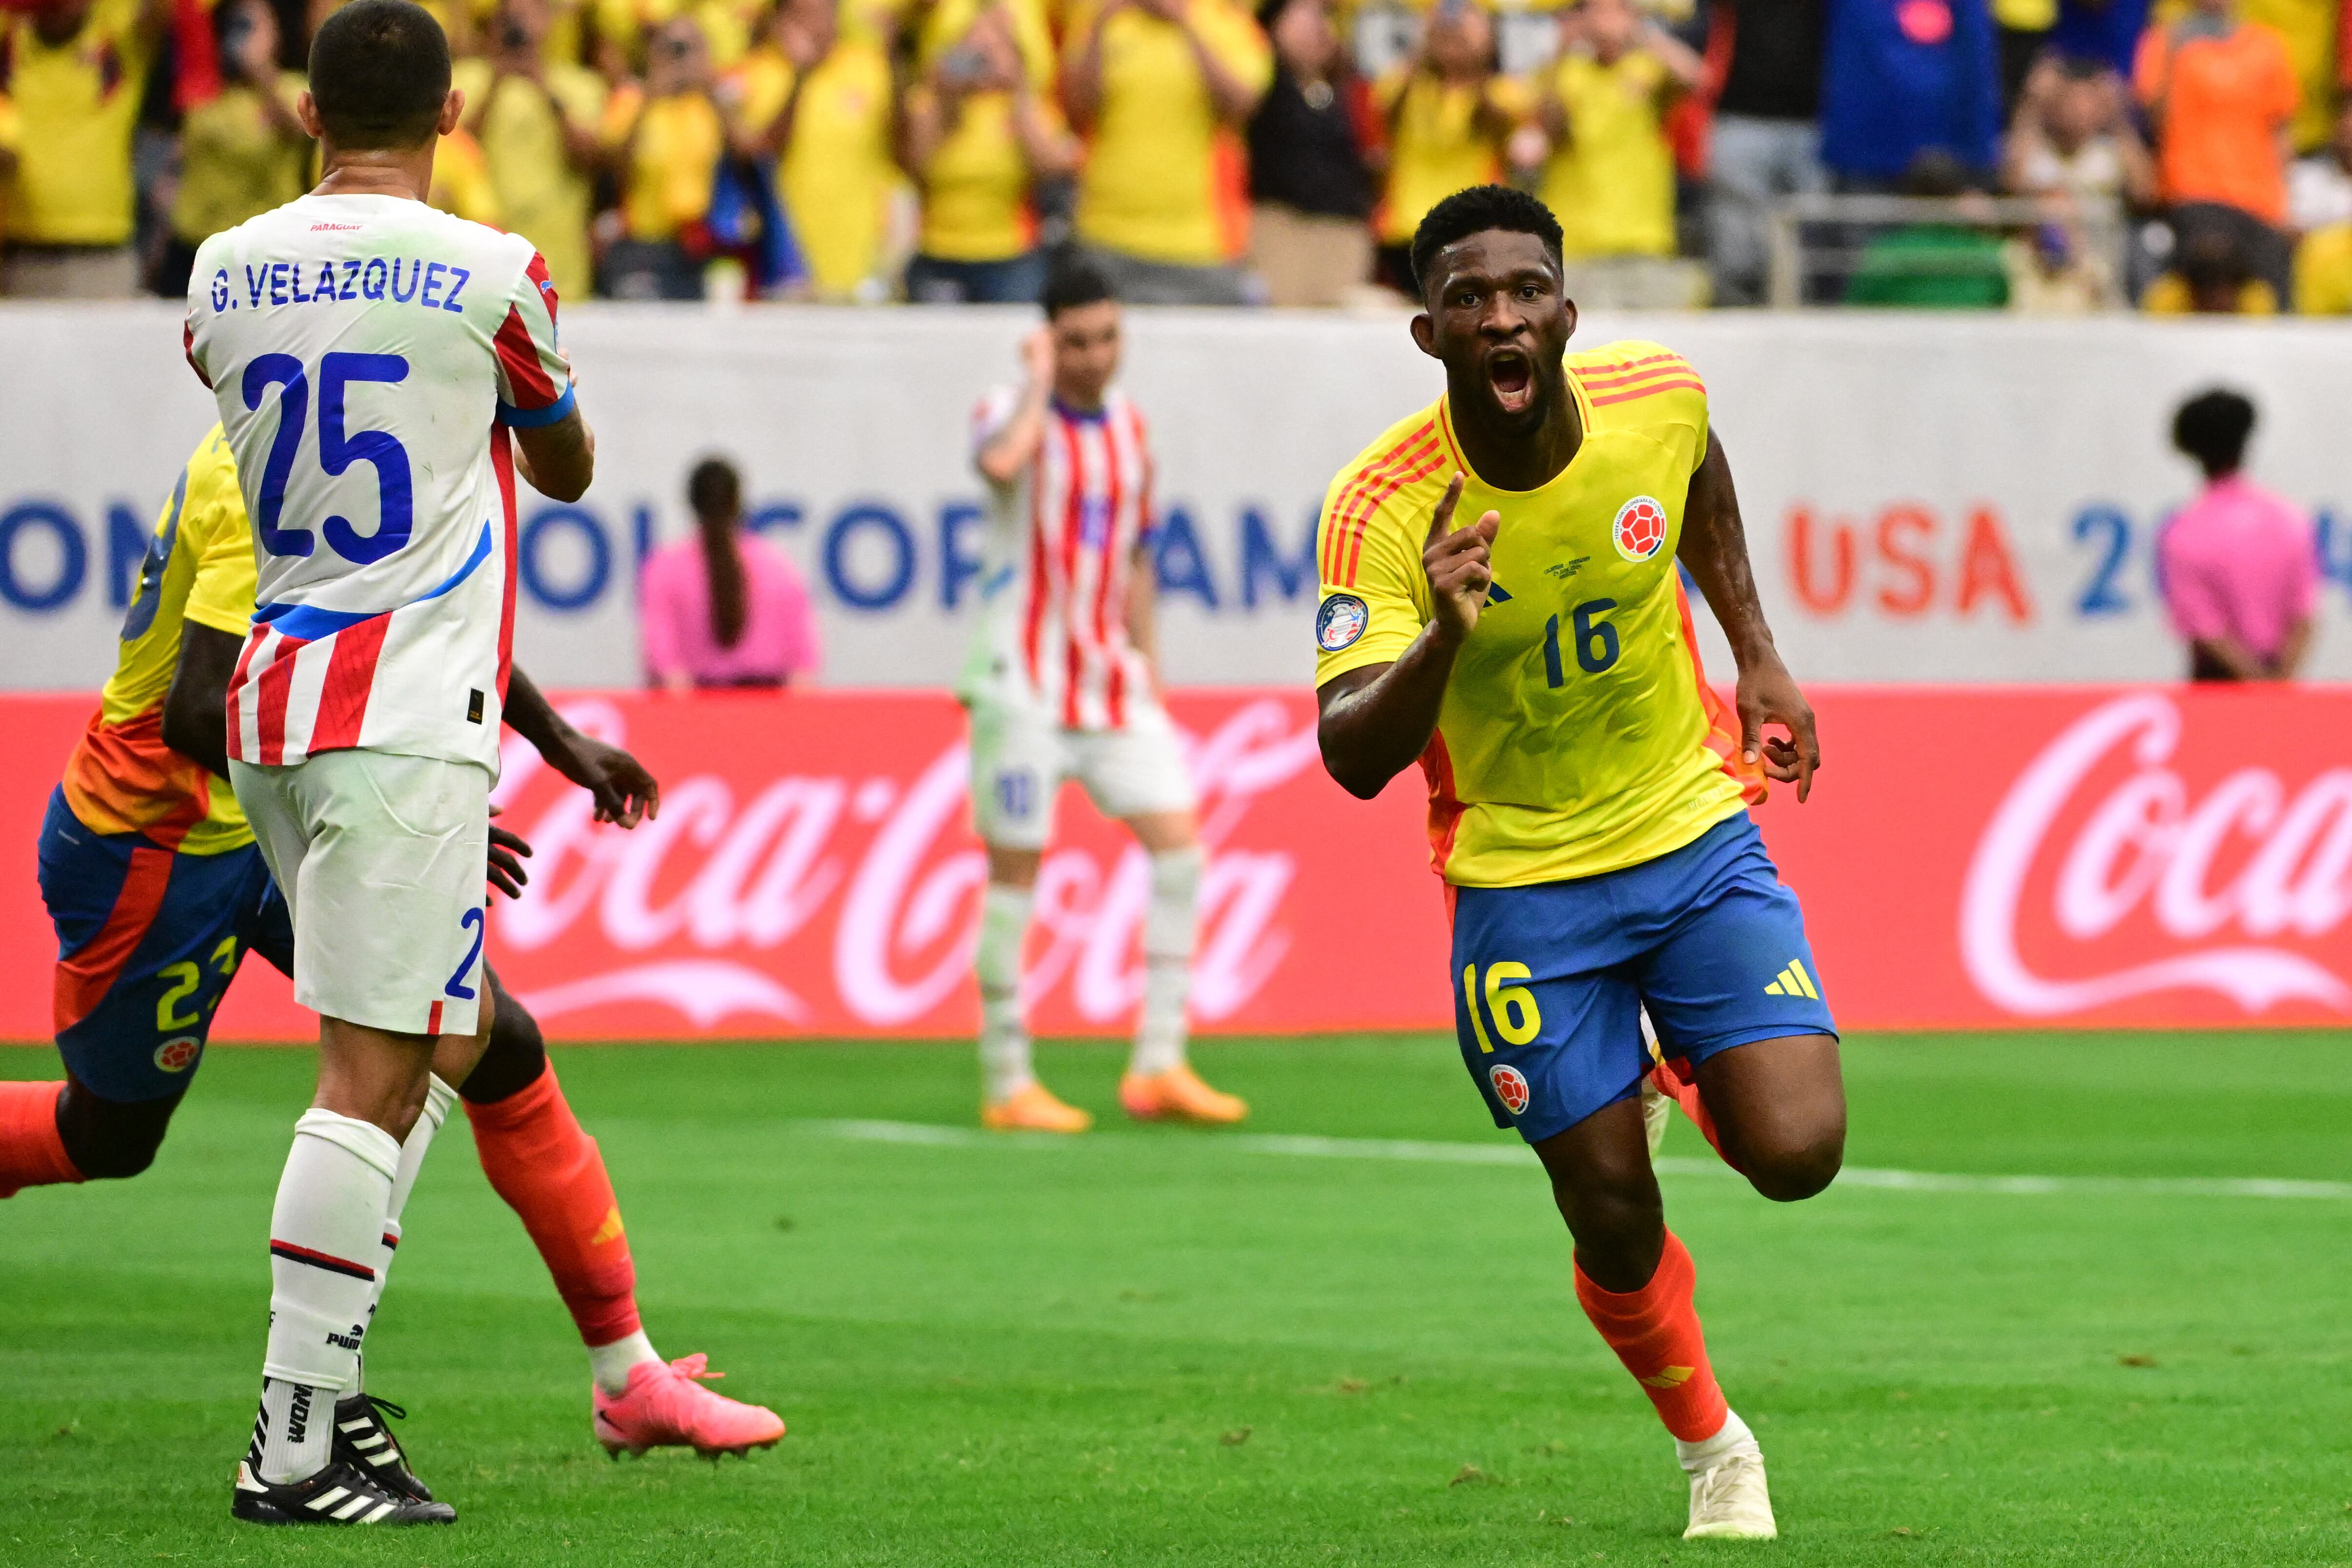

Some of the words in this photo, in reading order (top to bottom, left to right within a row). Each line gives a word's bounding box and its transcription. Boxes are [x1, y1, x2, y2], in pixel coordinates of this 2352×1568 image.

[310, 223, 363, 232] PARAGUAY
[212, 269, 238, 313] G.
[246, 257, 471, 313] VELAZQUEZ
[242, 352, 413, 565] 25
[1783, 503, 2034, 624] USA
[1544, 597, 1620, 689] 16
[1463, 961, 1541, 1053] 16
